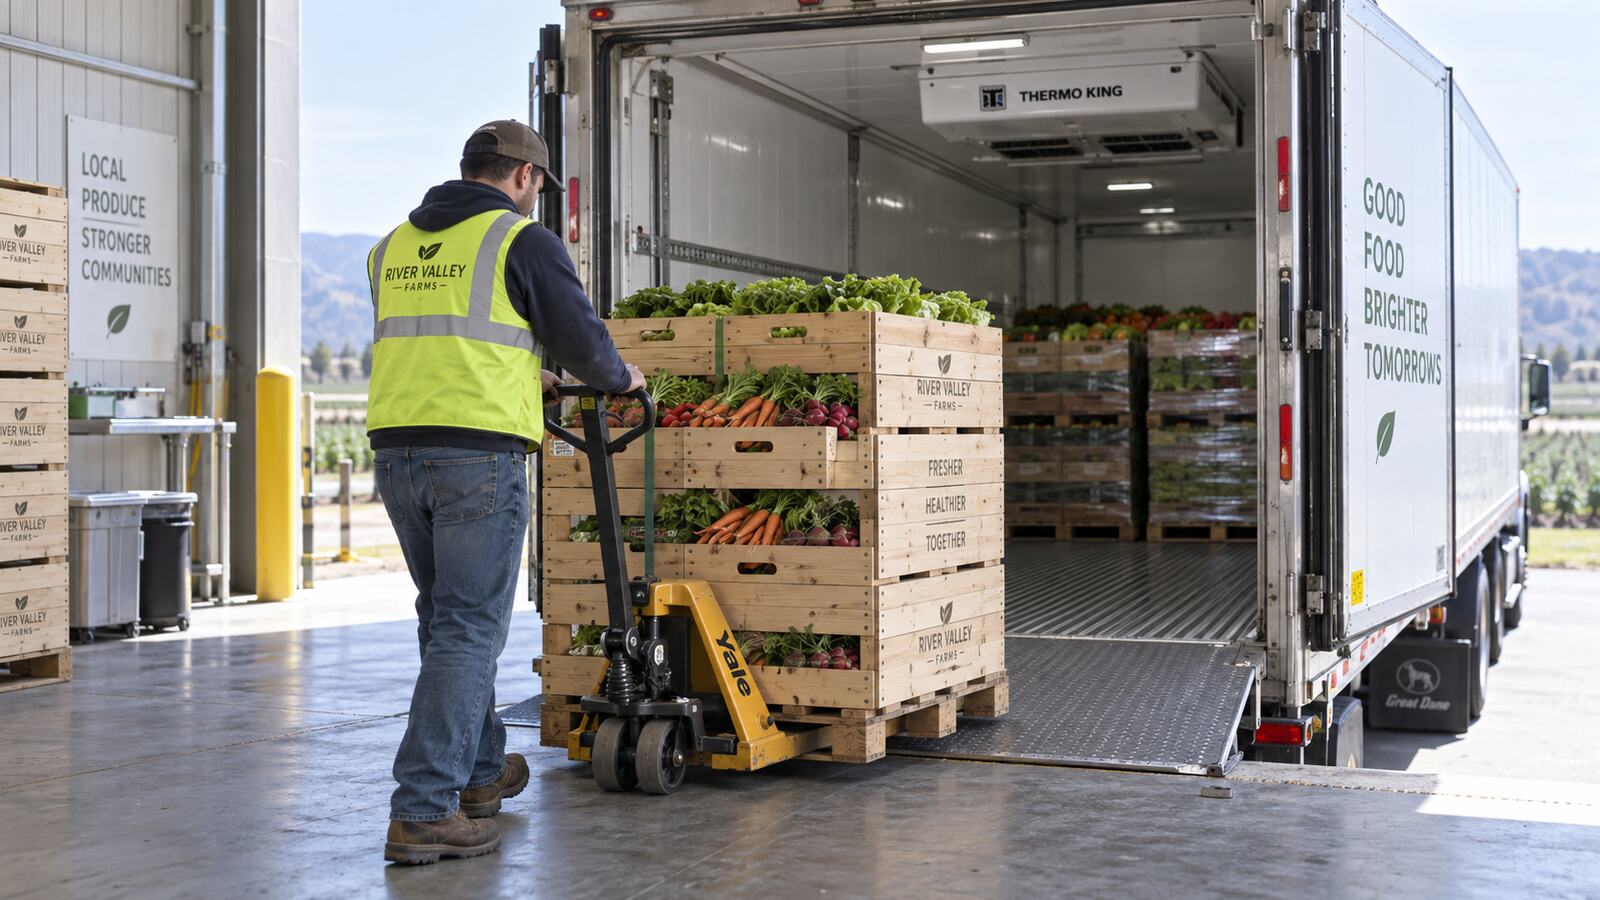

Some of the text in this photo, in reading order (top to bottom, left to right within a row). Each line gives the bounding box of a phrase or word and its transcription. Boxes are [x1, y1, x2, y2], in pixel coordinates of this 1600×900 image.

[1019, 85, 1123, 102] THERMO KING
[82, 152, 127, 182] LOCAL
[82, 187, 146, 219] PRODUCE
[1363, 177, 1405, 227] GOOD
[19, 242, 46, 256] VALLEY
[82, 226, 151, 255] STRONGER
[1364, 231, 1404, 278] FOOD
[81, 258, 172, 287] COMMUNITIES
[385, 264, 466, 282] RIVER VALLEY
[404, 281, 437, 292] FARMS
[1364, 287, 1428, 335] BRIGHTER
[19, 333, 46, 345] VALLEY
[1364, 342, 1442, 386] TOMORROWS
[917, 379, 971, 397] RIVER VALLEY
[934, 400, 956, 411] FARMS
[19, 425, 46, 436] VALLEY
[928, 459, 963, 477] FRESHER
[925, 495, 966, 514] HEALTHIER
[20, 518, 47, 530] VALLEY
[926, 531, 966, 552] TOGETHER
[20, 611, 47, 625] VALLEY
[919, 624, 973, 654] RIVER VALLEY
[716, 630, 751, 697] Yale
[1385, 694, 1451, 710] Great Dane
